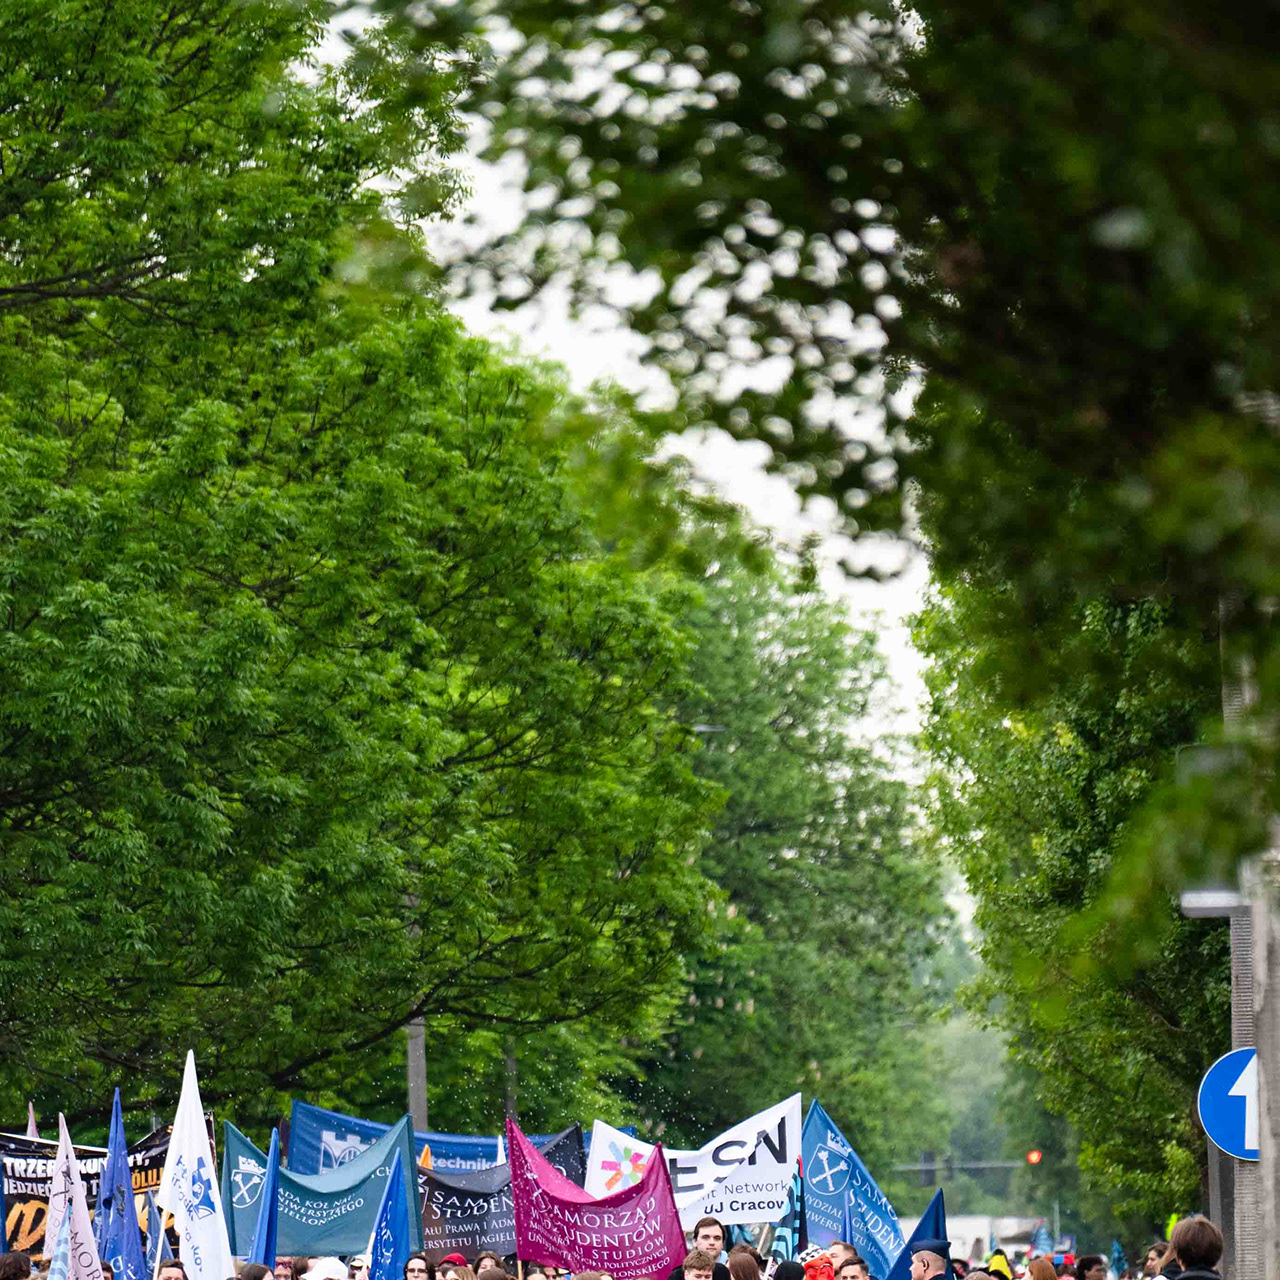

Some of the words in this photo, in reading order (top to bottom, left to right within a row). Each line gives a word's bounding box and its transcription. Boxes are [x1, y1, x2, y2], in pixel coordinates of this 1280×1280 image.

[669, 1116, 787, 1194] ESN
[3, 1157, 56, 1178] TRZEB
[4, 1178, 52, 1198] IEDZIEĆ
[278, 1187, 301, 1204] ADA
[724, 1180, 789, 1195] Network
[554, 1198, 655, 1228] AMORZĄD
[704, 1202, 723, 1214] UJ
[592, 1234, 665, 1260] STUDIÓW
